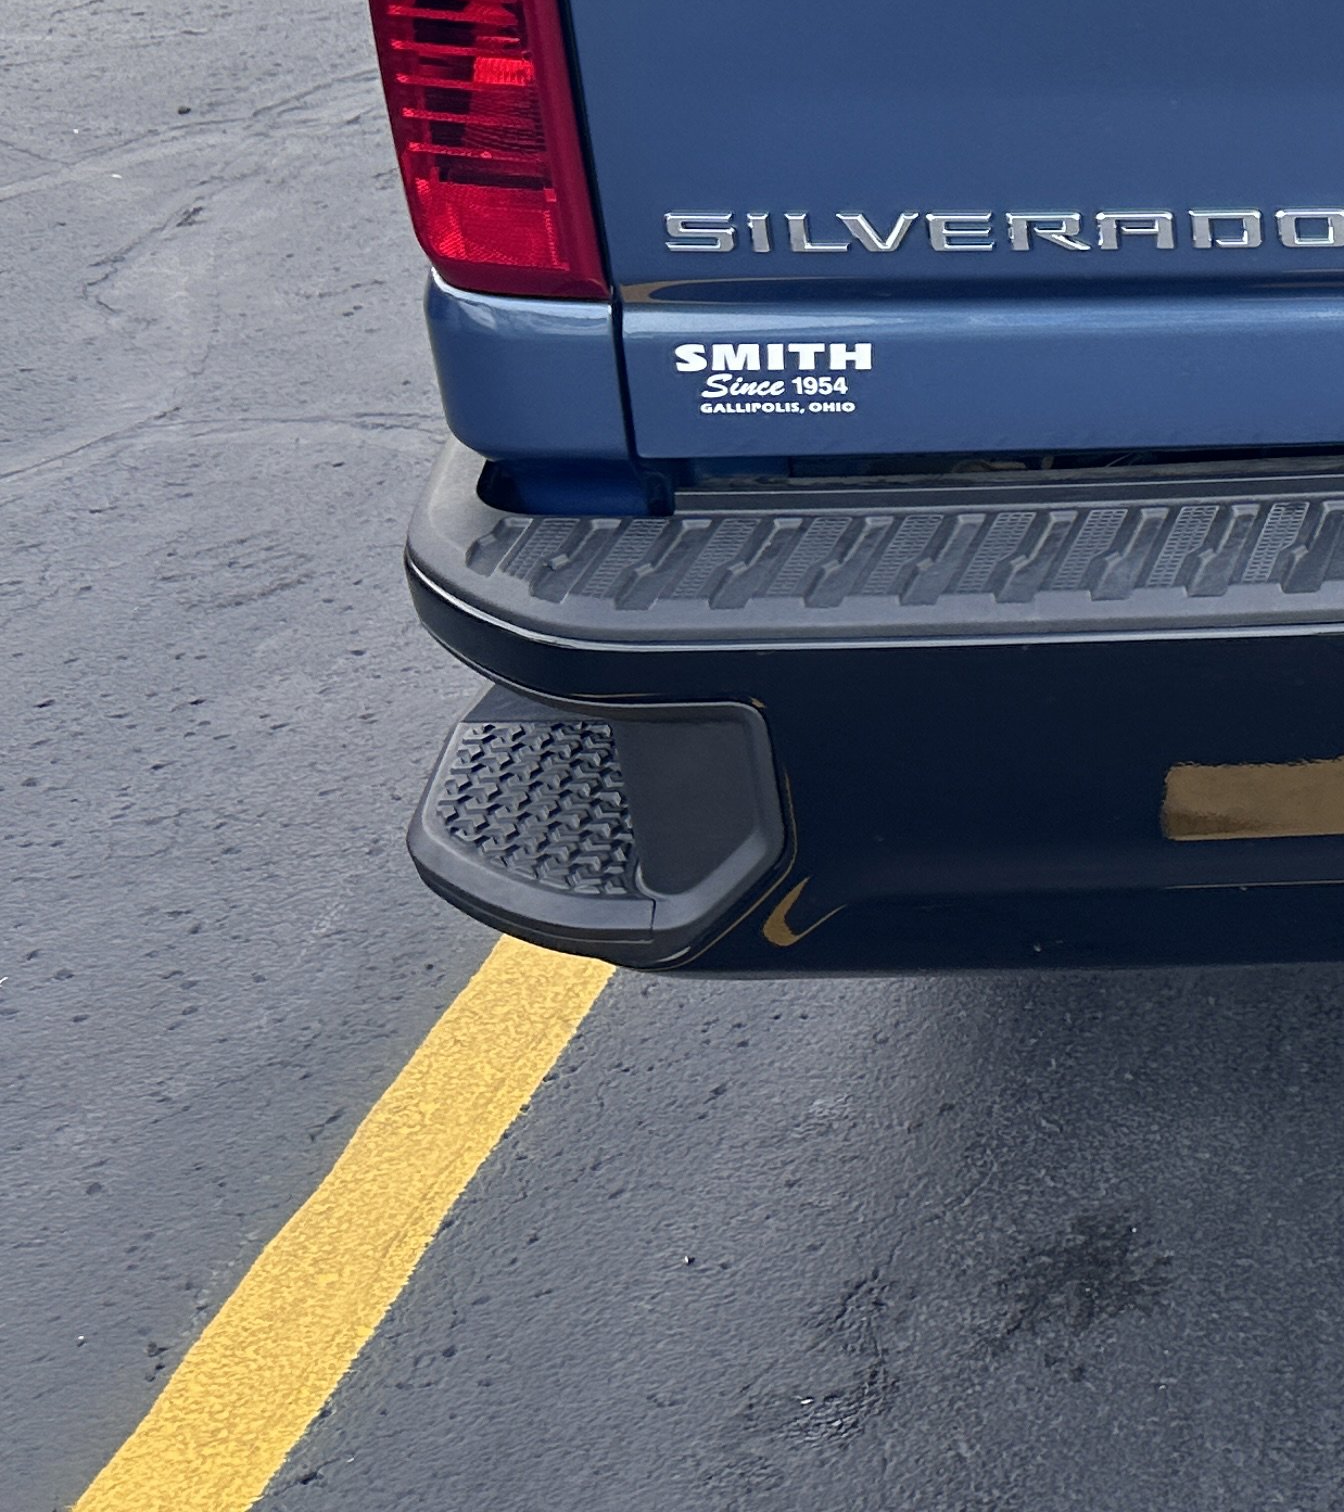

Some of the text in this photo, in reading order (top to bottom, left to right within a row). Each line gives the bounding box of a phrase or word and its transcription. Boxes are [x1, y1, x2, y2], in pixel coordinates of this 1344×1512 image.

[674, 343, 872, 372] SMITH
[700, 373, 849, 399] Since 1954
[700, 402, 857, 414] GALLIPOLIS, OHIO
